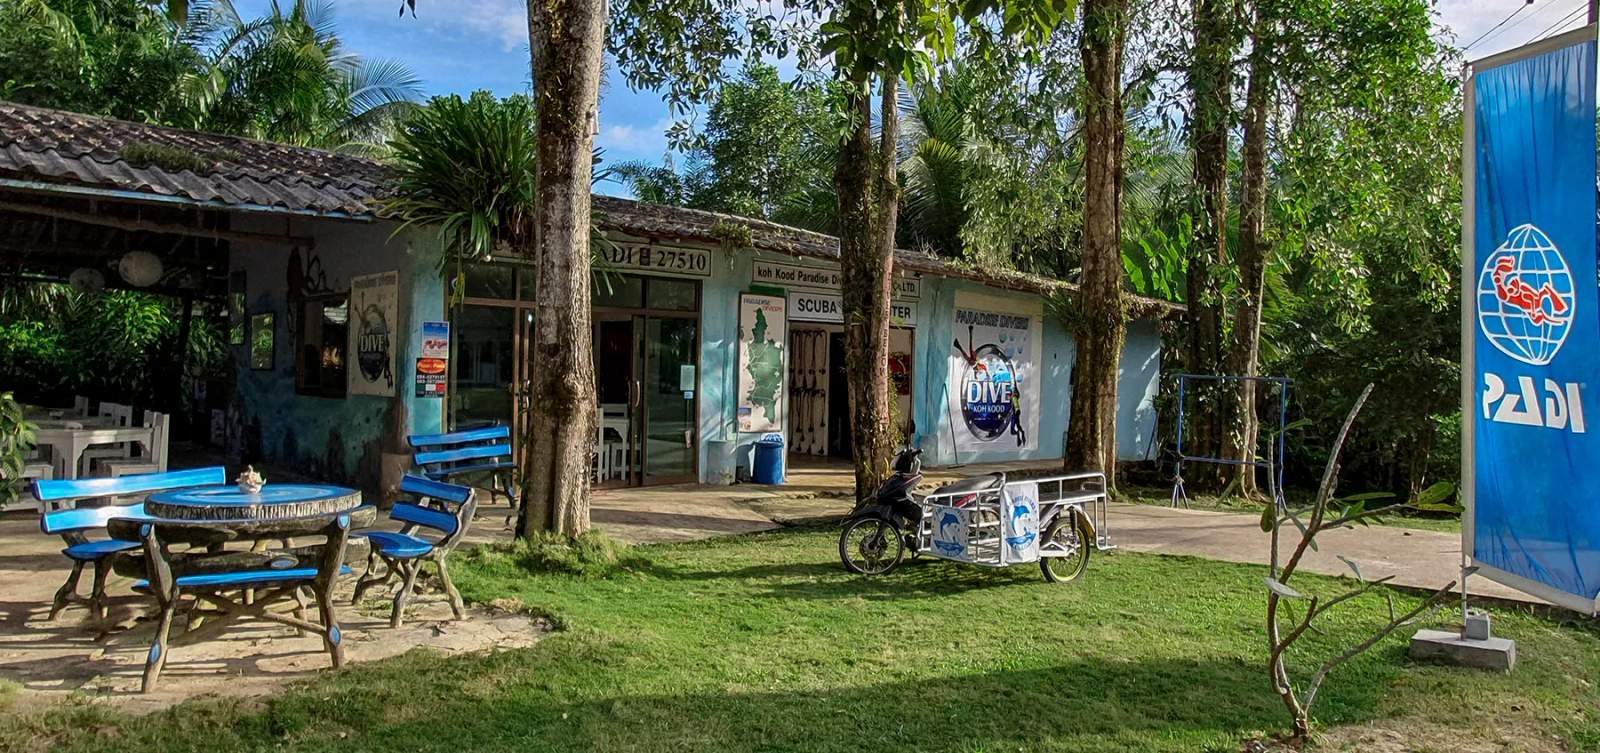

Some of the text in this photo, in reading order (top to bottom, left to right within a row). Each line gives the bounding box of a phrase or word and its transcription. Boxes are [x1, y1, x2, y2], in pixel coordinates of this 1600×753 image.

[599, 246, 706, 272] ADI 27510
[757, 266, 773, 279] koh
[775, 268, 795, 281] Kood
[799, 270, 829, 284] Paradise
[798, 298, 911, 319] SCUBA TER
[360, 334, 385, 353] DIVE
[967, 381, 1011, 404] DIVE
[1482, 372, 1585, 434] PADI
[973, 404, 1005, 414] KOH KOOD
